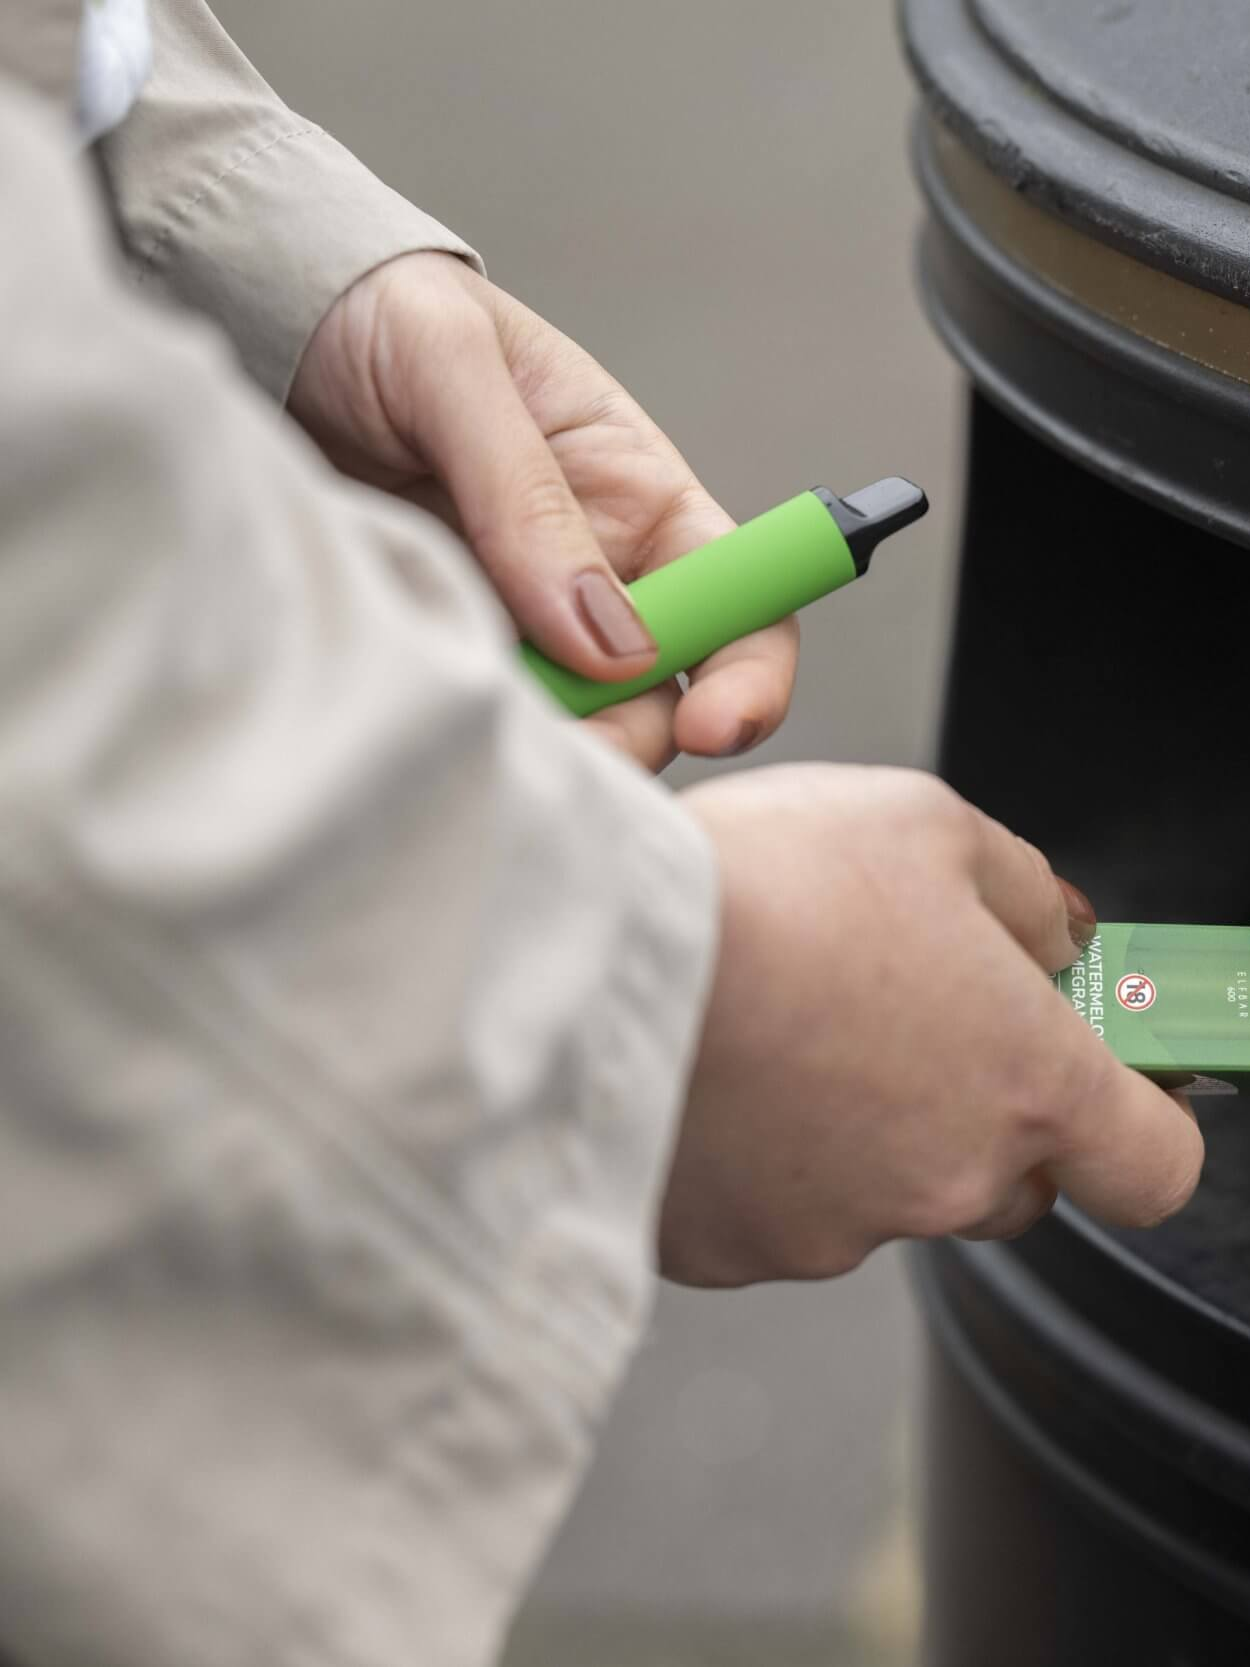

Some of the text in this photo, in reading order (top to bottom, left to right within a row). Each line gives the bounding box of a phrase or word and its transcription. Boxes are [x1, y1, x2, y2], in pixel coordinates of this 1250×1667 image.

[1088, 935, 1104, 1041] WATERMELO
[1126, 980, 1146, 1004] 18
[1227, 986, 1236, 1002] 600
[1237, 971, 1249, 1018] ELFBAR
